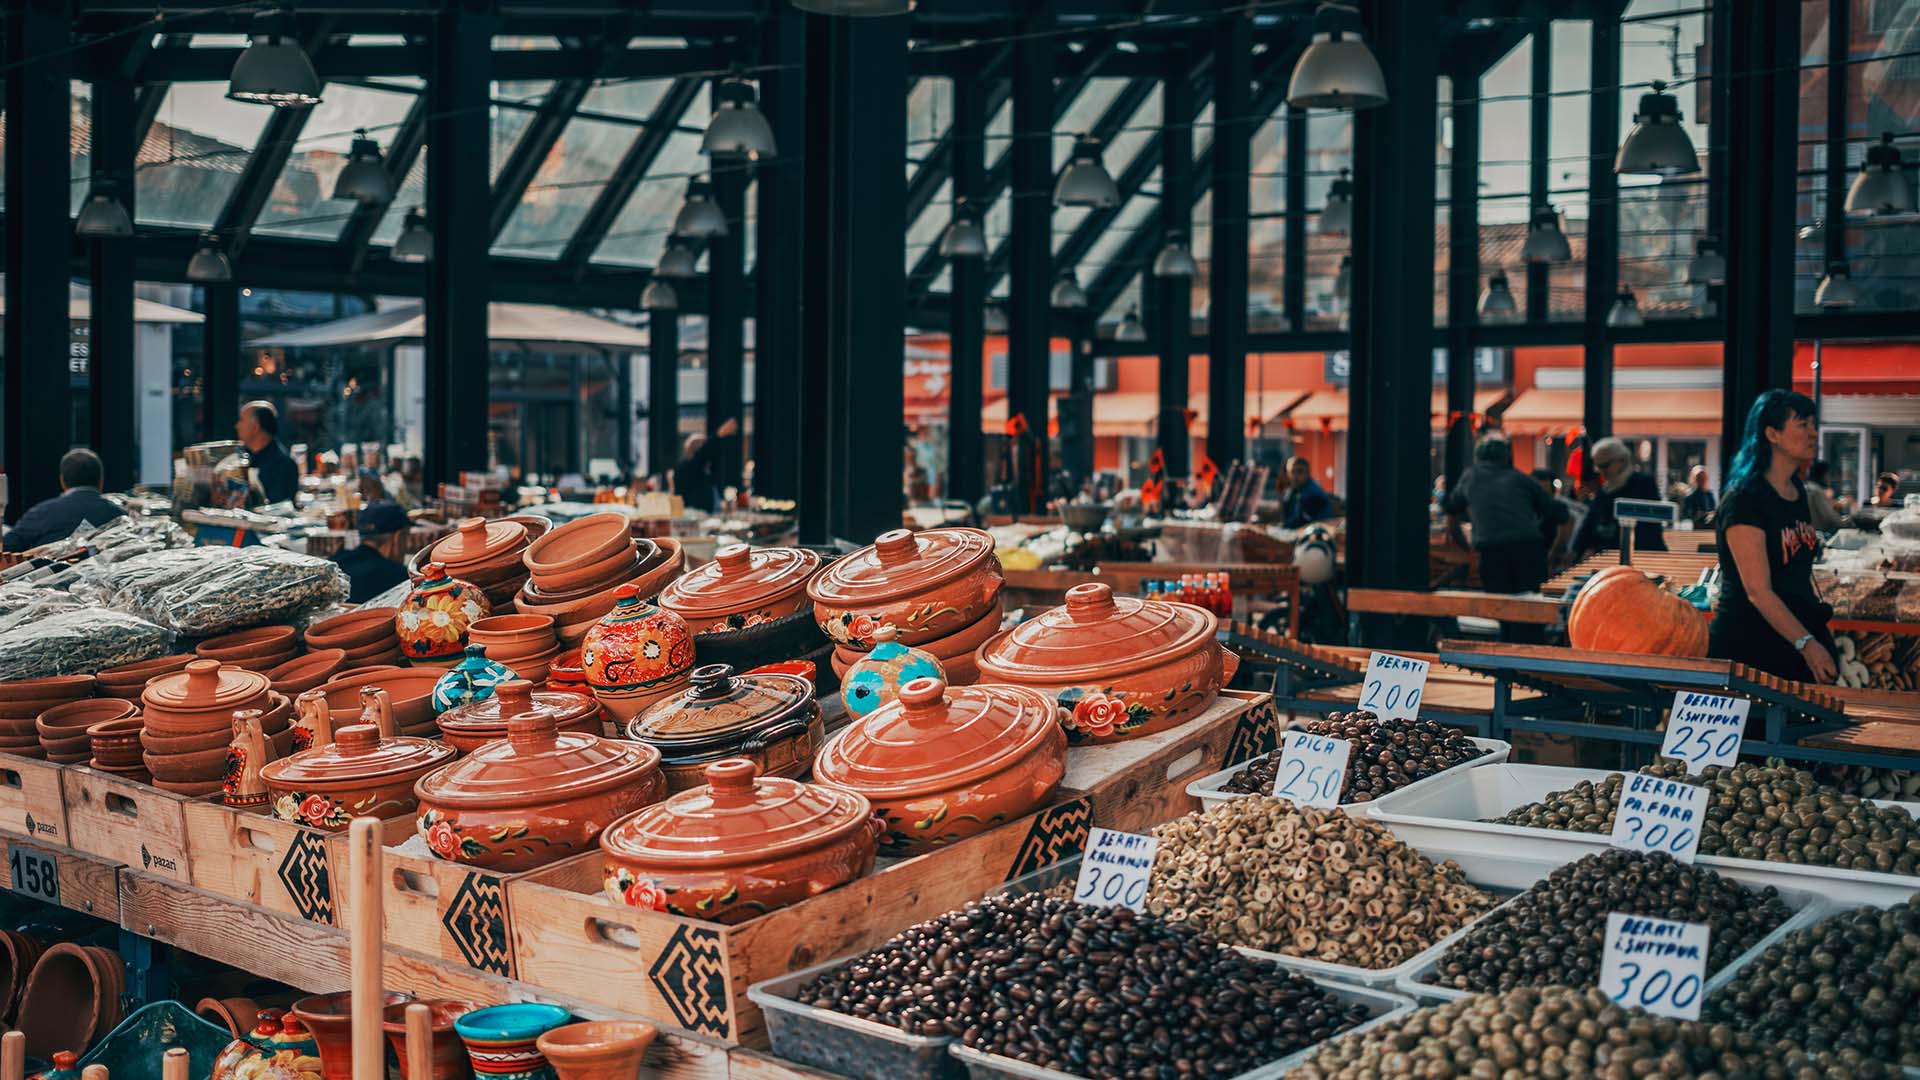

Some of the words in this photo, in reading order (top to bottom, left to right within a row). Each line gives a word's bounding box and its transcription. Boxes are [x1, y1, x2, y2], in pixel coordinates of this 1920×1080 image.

[1376, 655, 1424, 673] BERATI
[1363, 680, 1421, 710] 200
[1683, 693, 1735, 710] BERATI
[1295, 735, 1336, 755] PICA
[1669, 726, 1739, 763] 250
[1279, 758, 1342, 802] 250
[1630, 776, 1696, 801] BERATI
[37, 822, 58, 836] pazari
[1098, 831, 1148, 849] BERATI
[1622, 816, 1696, 852] 300
[11, 849, 57, 899] 158
[153, 855, 177, 872] pazari
[1079, 867, 1146, 906] 300
[1620, 917, 1687, 939] BERATI
[1614, 962, 1700, 1009] 300
